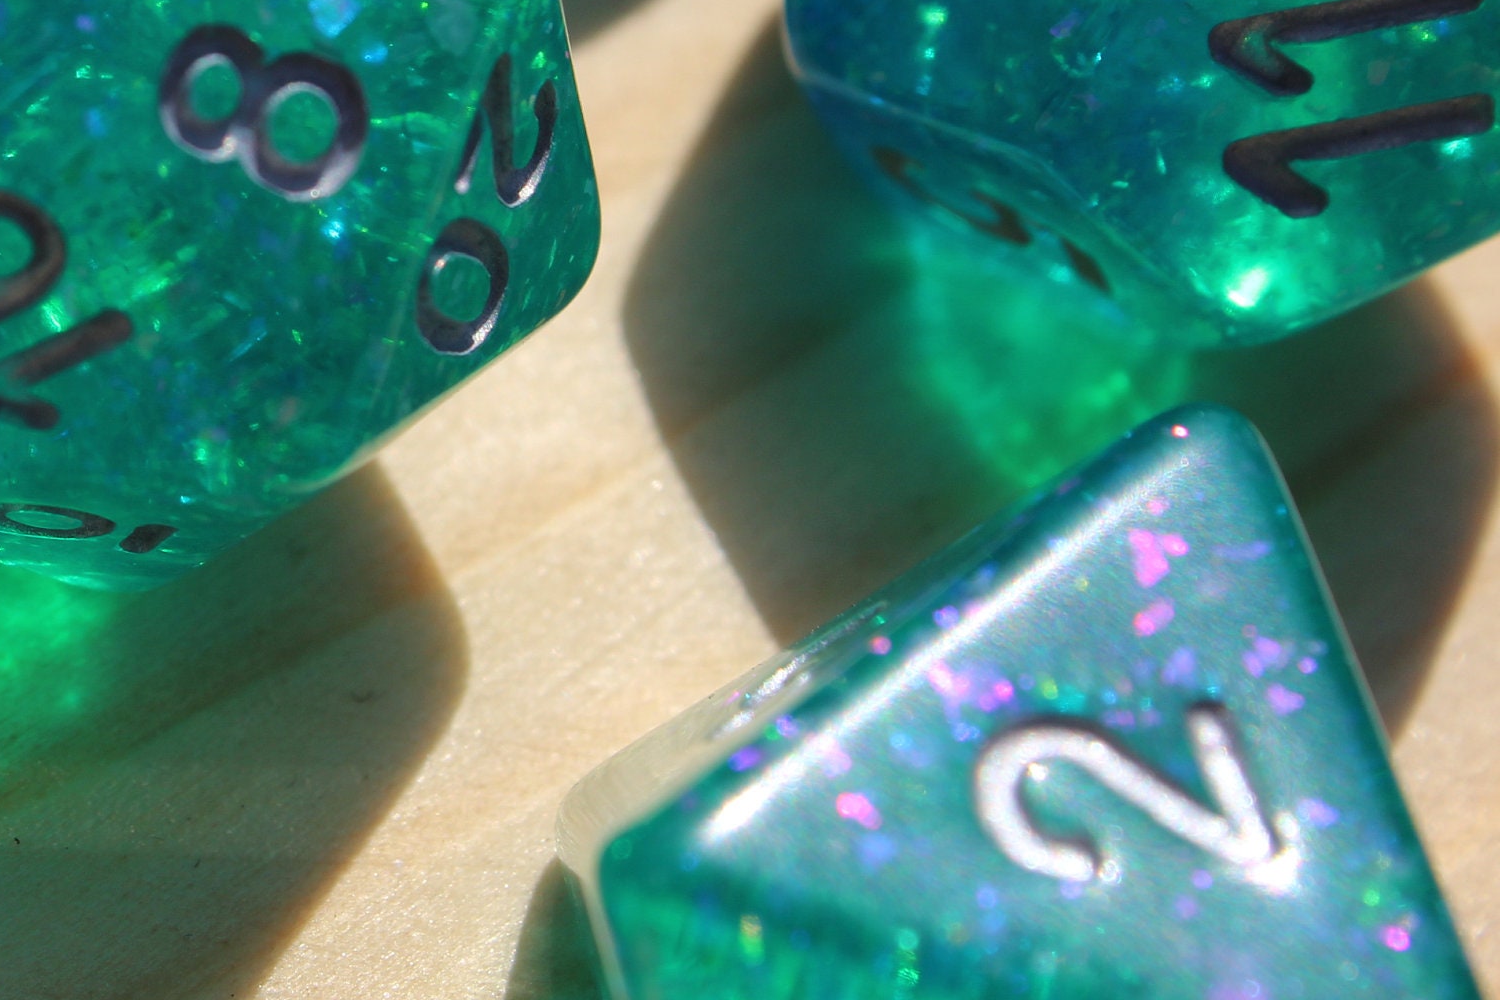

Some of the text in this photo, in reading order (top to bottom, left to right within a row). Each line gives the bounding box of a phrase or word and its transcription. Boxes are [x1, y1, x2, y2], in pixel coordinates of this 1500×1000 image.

[158, 23, 370, 202] 8
[415, 52, 557, 356] 20
[975, 699, 1299, 894] 2
